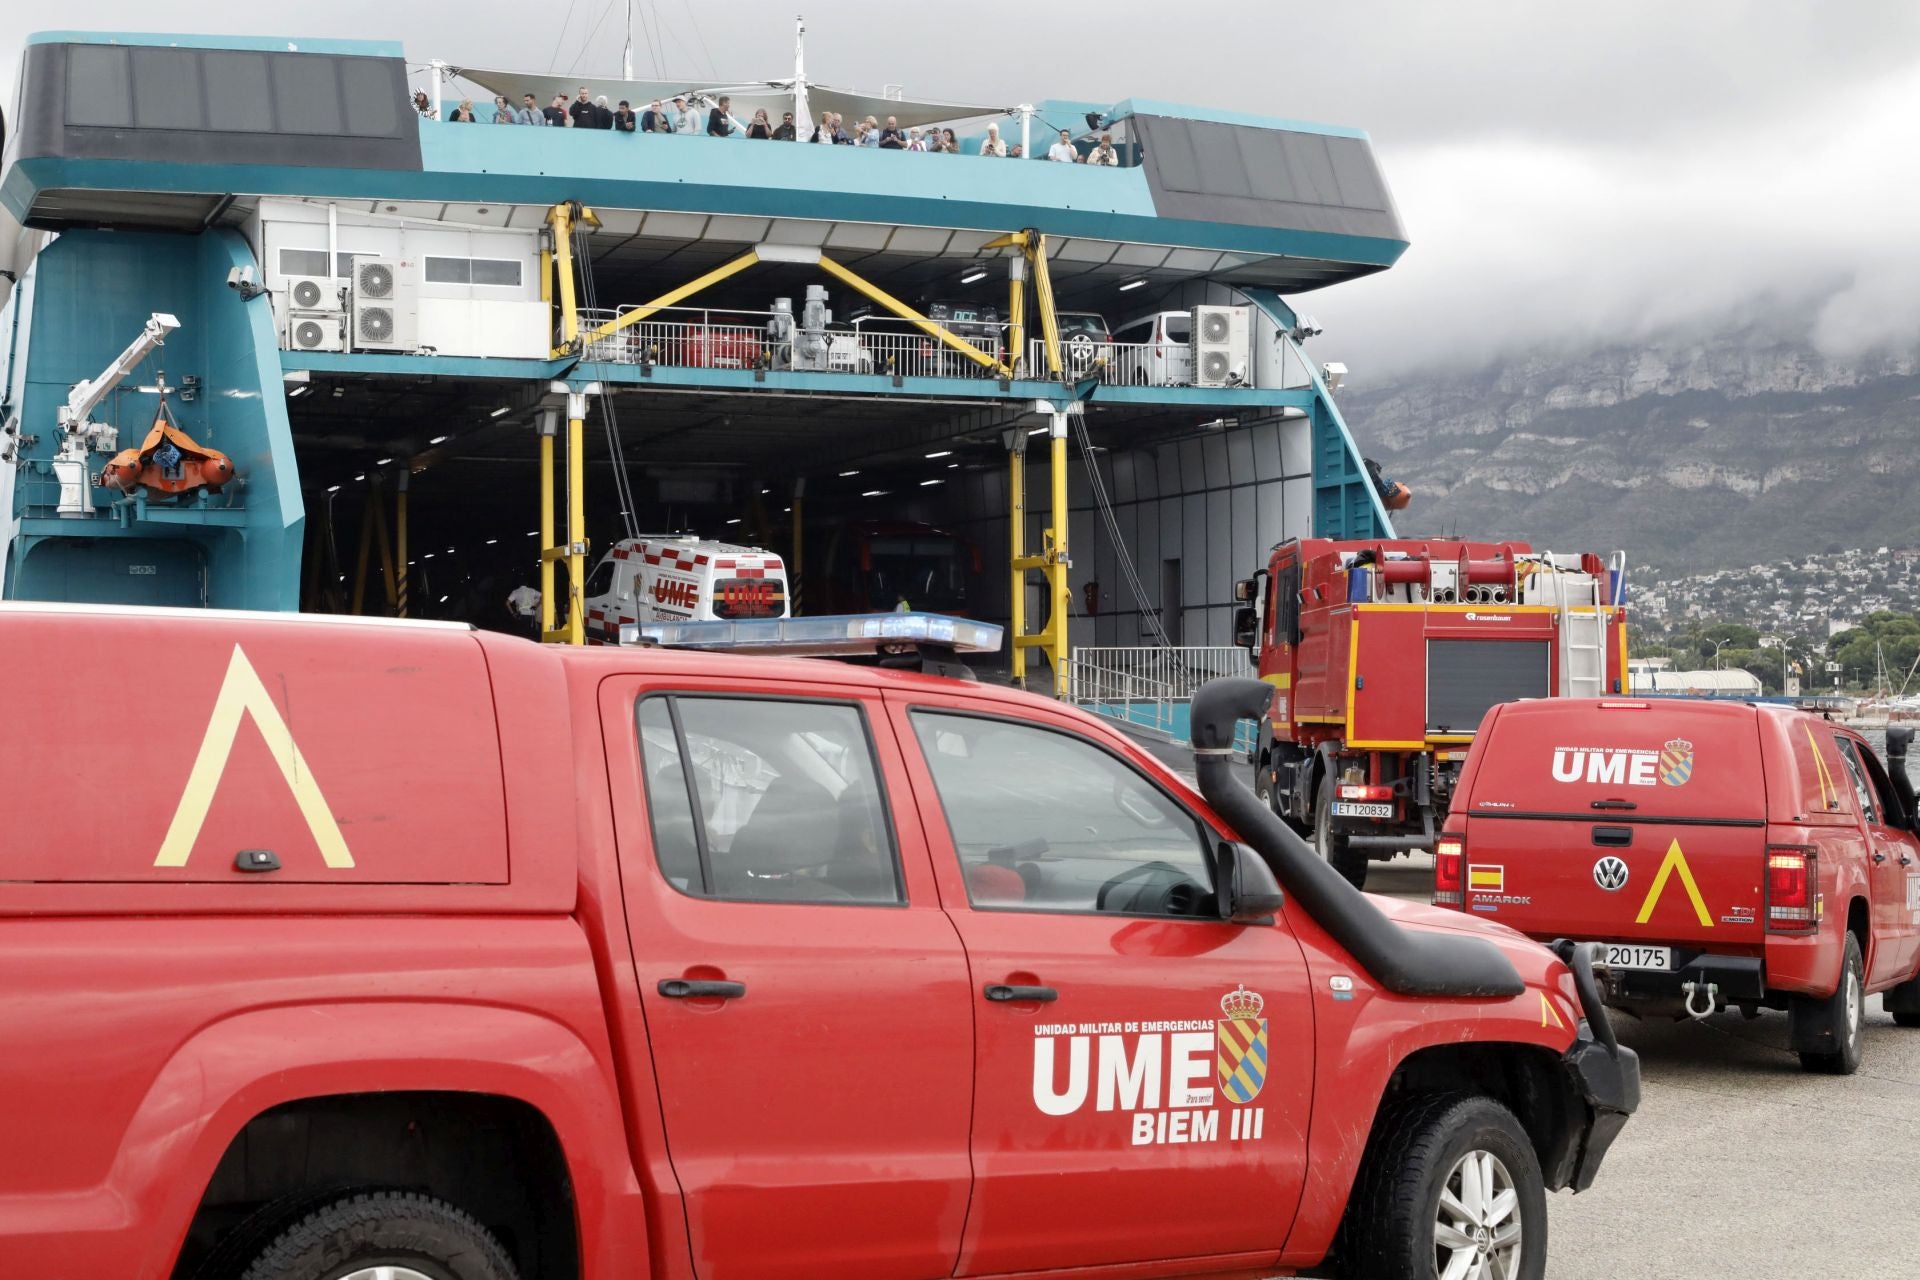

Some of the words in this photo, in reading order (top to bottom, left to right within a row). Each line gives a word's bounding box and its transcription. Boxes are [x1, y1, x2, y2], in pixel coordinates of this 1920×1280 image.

[655, 578, 698, 609] UME
[724, 583, 775, 605] UME
[1552, 751, 1659, 785] UME
[1338, 804, 1352, 814] ET
[1354, 804, 1389, 817] 120832
[1472, 894, 1531, 904] AMAROK
[1602, 947, 1665, 967] 20175
[1034, 1024, 1076, 1036] UNIDAD
[1079, 1021, 1122, 1034] MILITAR
[1124, 1021, 1139, 1033] DE
[1141, 1020, 1215, 1033] EMERGENCIAS
[1033, 1032, 1214, 1116] UME
[1131, 1109, 1219, 1146] BIEM
[1230, 1107, 1264, 1141] III
